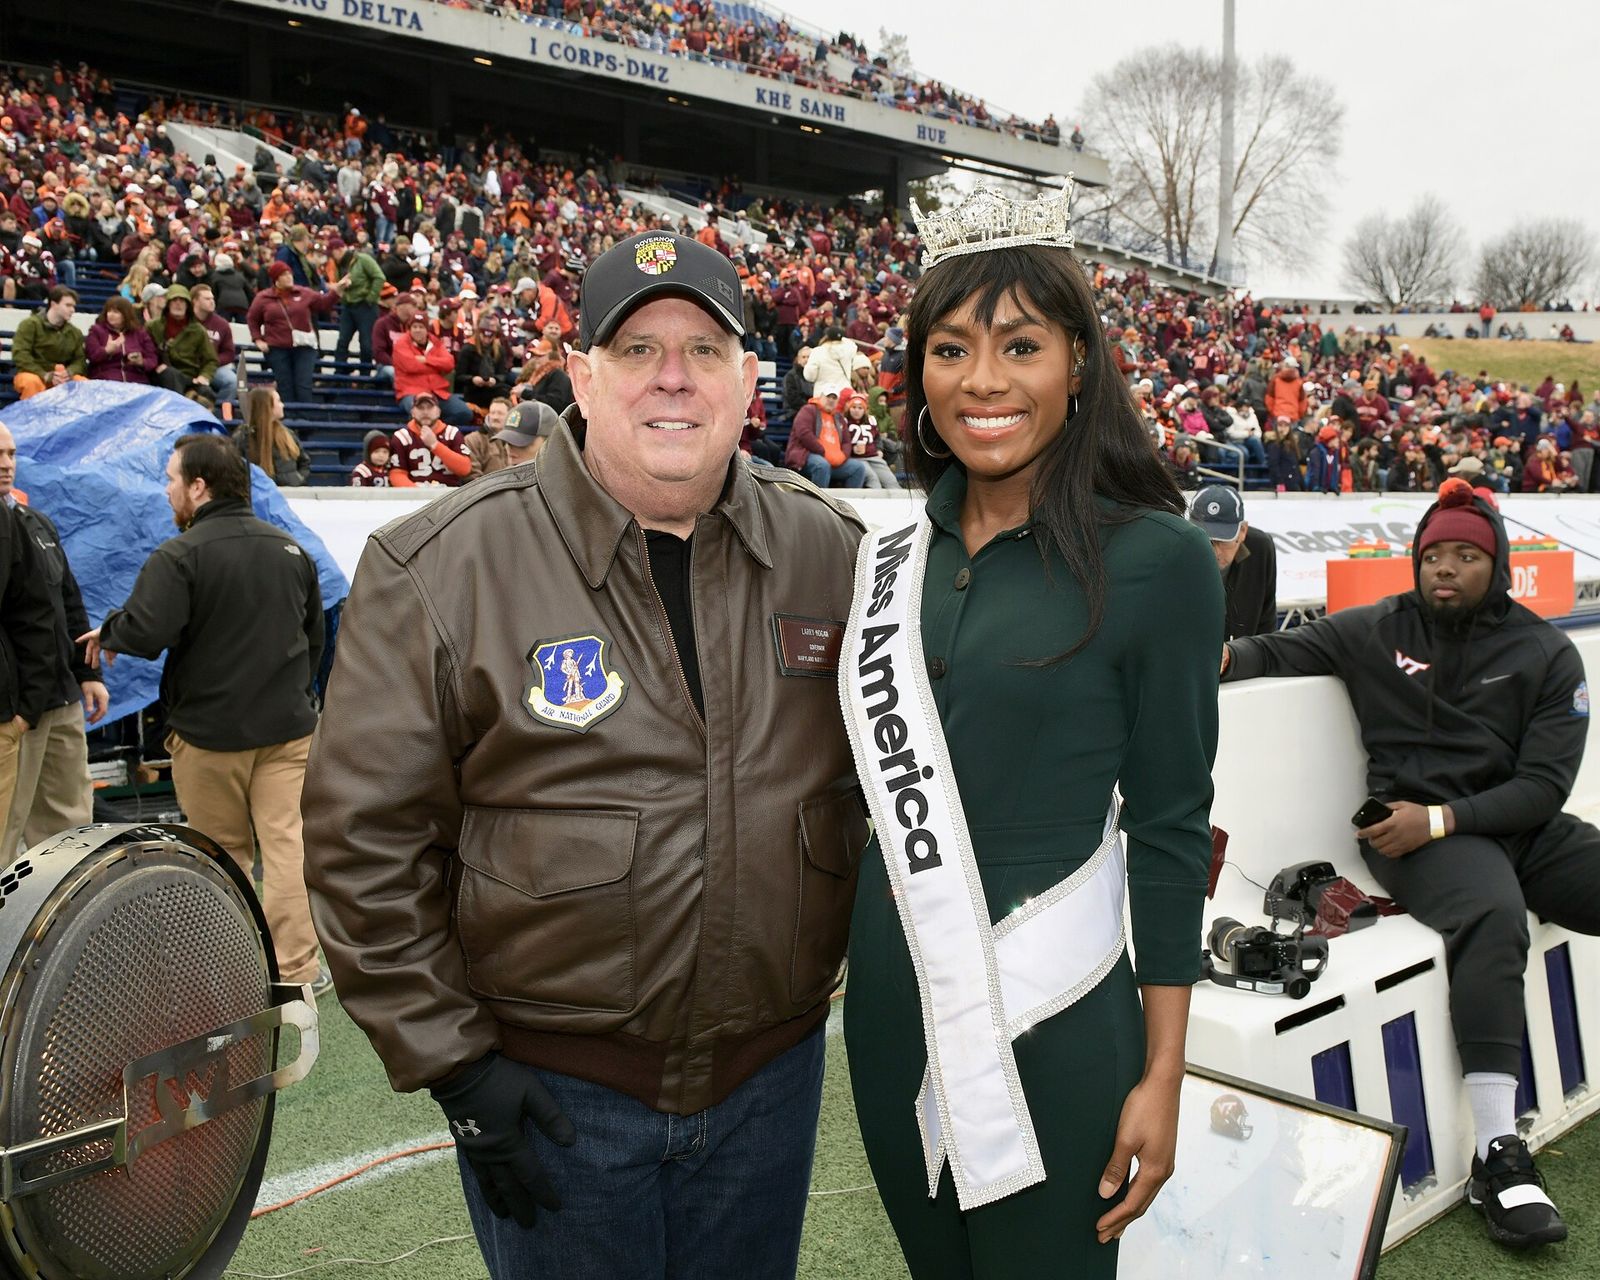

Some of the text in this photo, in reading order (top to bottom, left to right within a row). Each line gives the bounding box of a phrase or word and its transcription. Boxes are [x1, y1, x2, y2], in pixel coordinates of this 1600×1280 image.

[342, 0, 423, 31] DELTA
[530, 37, 669, 83] I CORPS-DMZ
[800, 98, 845, 121] SANH
[917, 124, 946, 144] HUE
[634, 237, 675, 249] GOVERNOR
[1395, 649, 1431, 676] VT
[541, 692, 616, 724] AIR NATIONAL GUARD
[858, 522, 943, 875] Miss America
